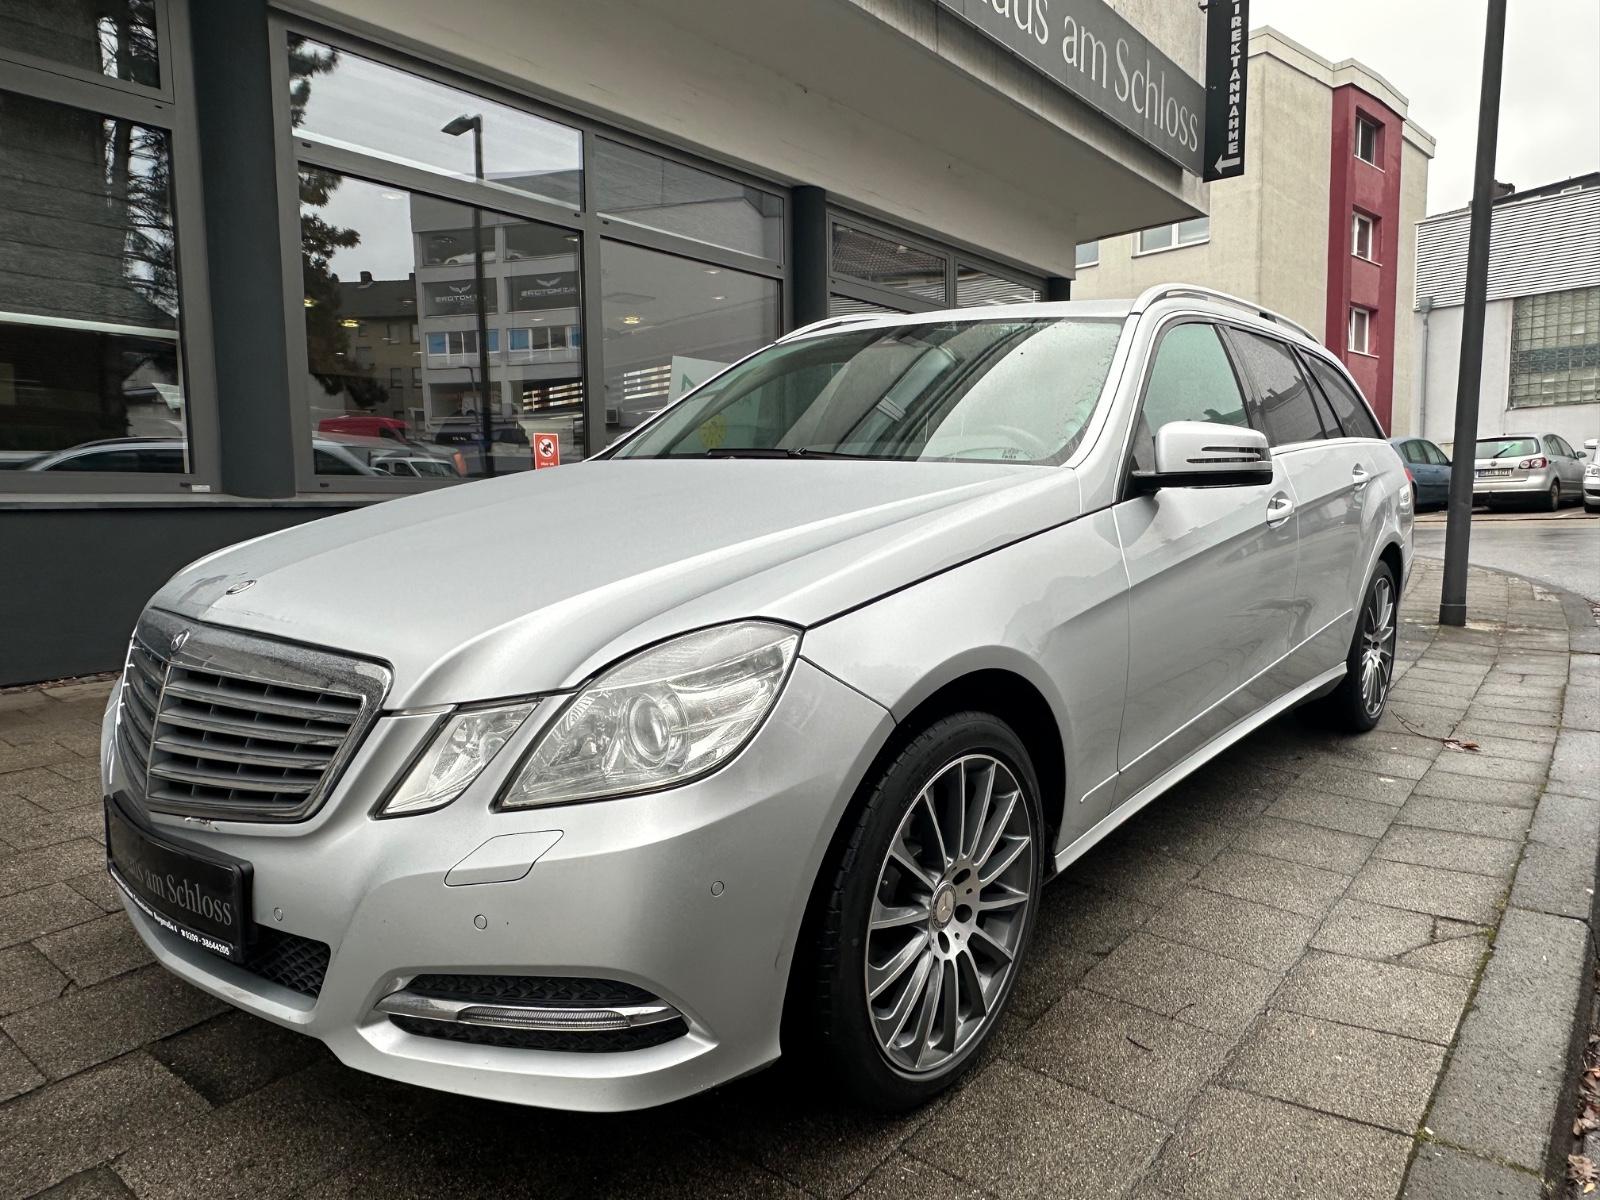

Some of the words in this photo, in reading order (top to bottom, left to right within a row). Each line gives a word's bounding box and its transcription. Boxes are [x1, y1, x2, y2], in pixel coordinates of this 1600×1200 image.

[1062, 15, 1107, 89] am
[1114, 37, 1198, 152] Schloss
[1227, 0, 1242, 155] IREKTANNAHME
[145, 868, 166, 900] am
[166, 873, 233, 926] Schloss
